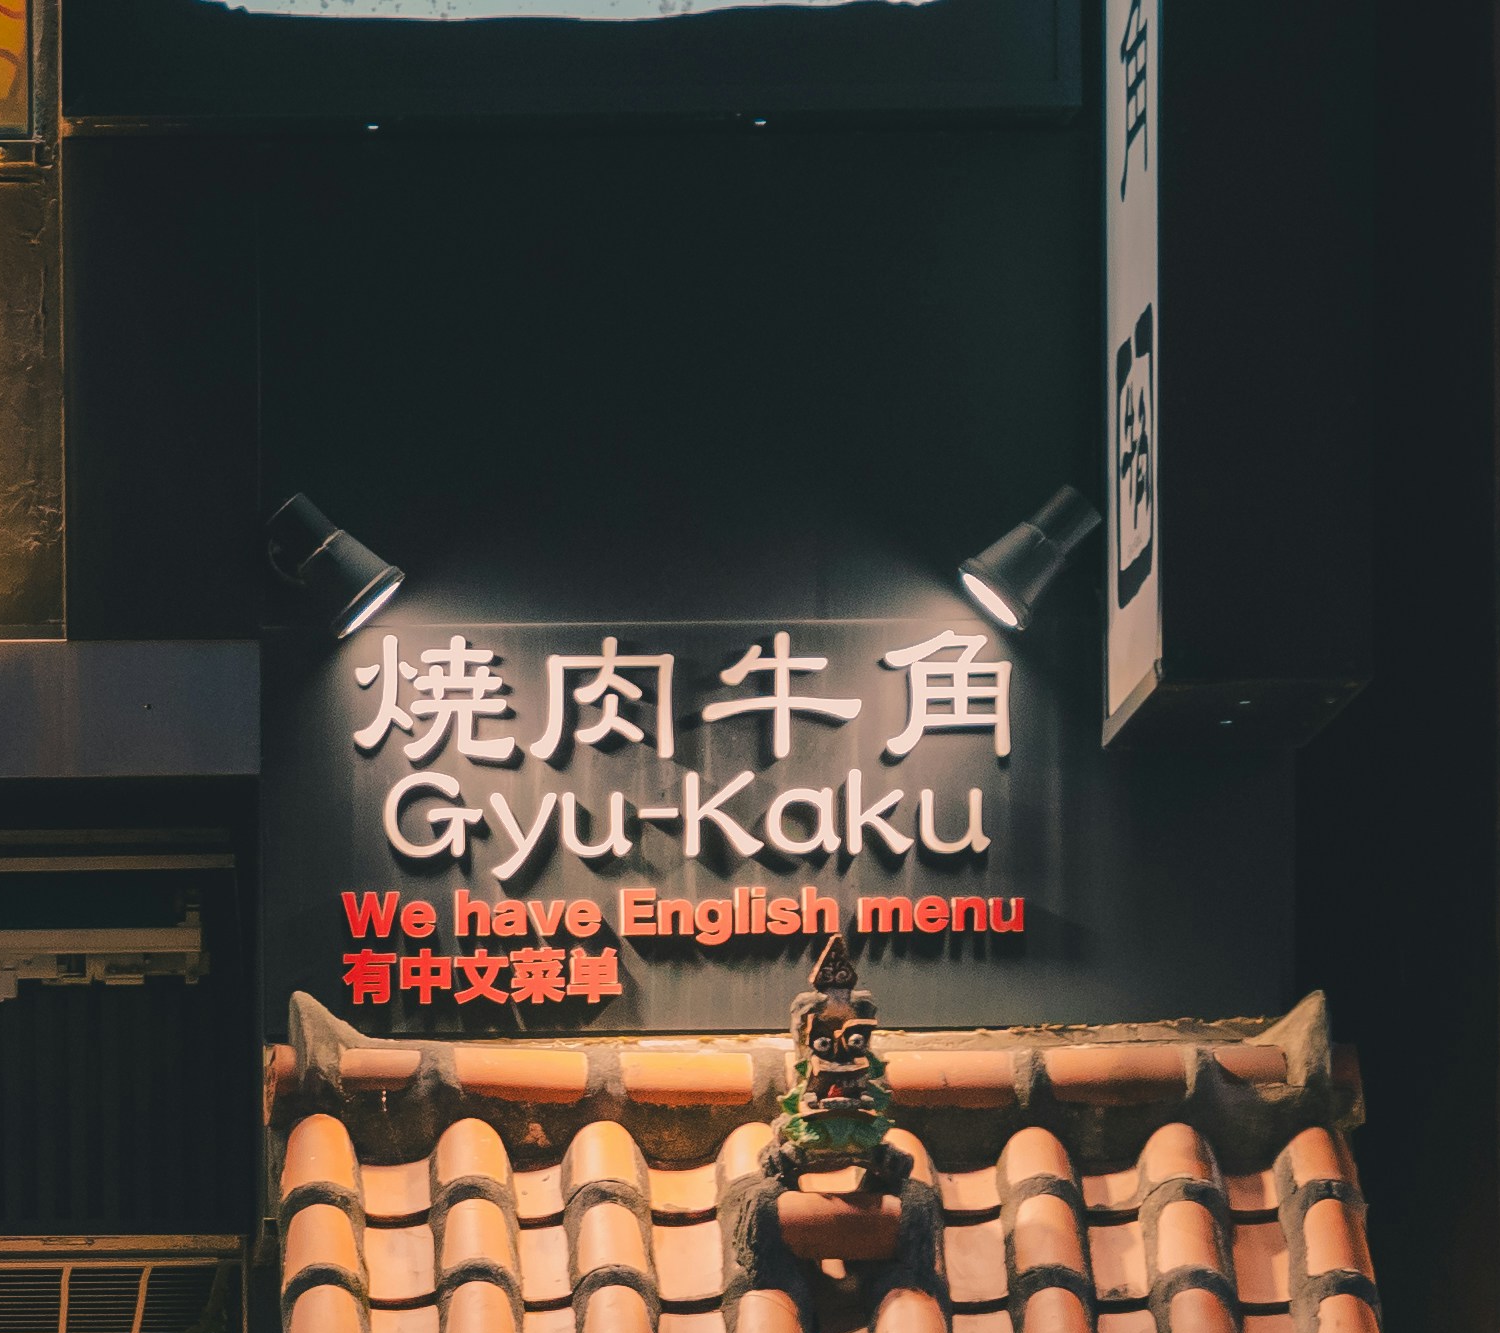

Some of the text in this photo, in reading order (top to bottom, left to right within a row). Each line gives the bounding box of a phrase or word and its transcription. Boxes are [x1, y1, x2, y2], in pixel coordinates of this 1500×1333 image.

[352, 630, 1012, 762] 焼肉牛角
[383, 769, 991, 881] Gyu-Kaku
[341, 886, 1027, 946] We have English menu
[342, 946, 623, 1005] 有中文菜单
